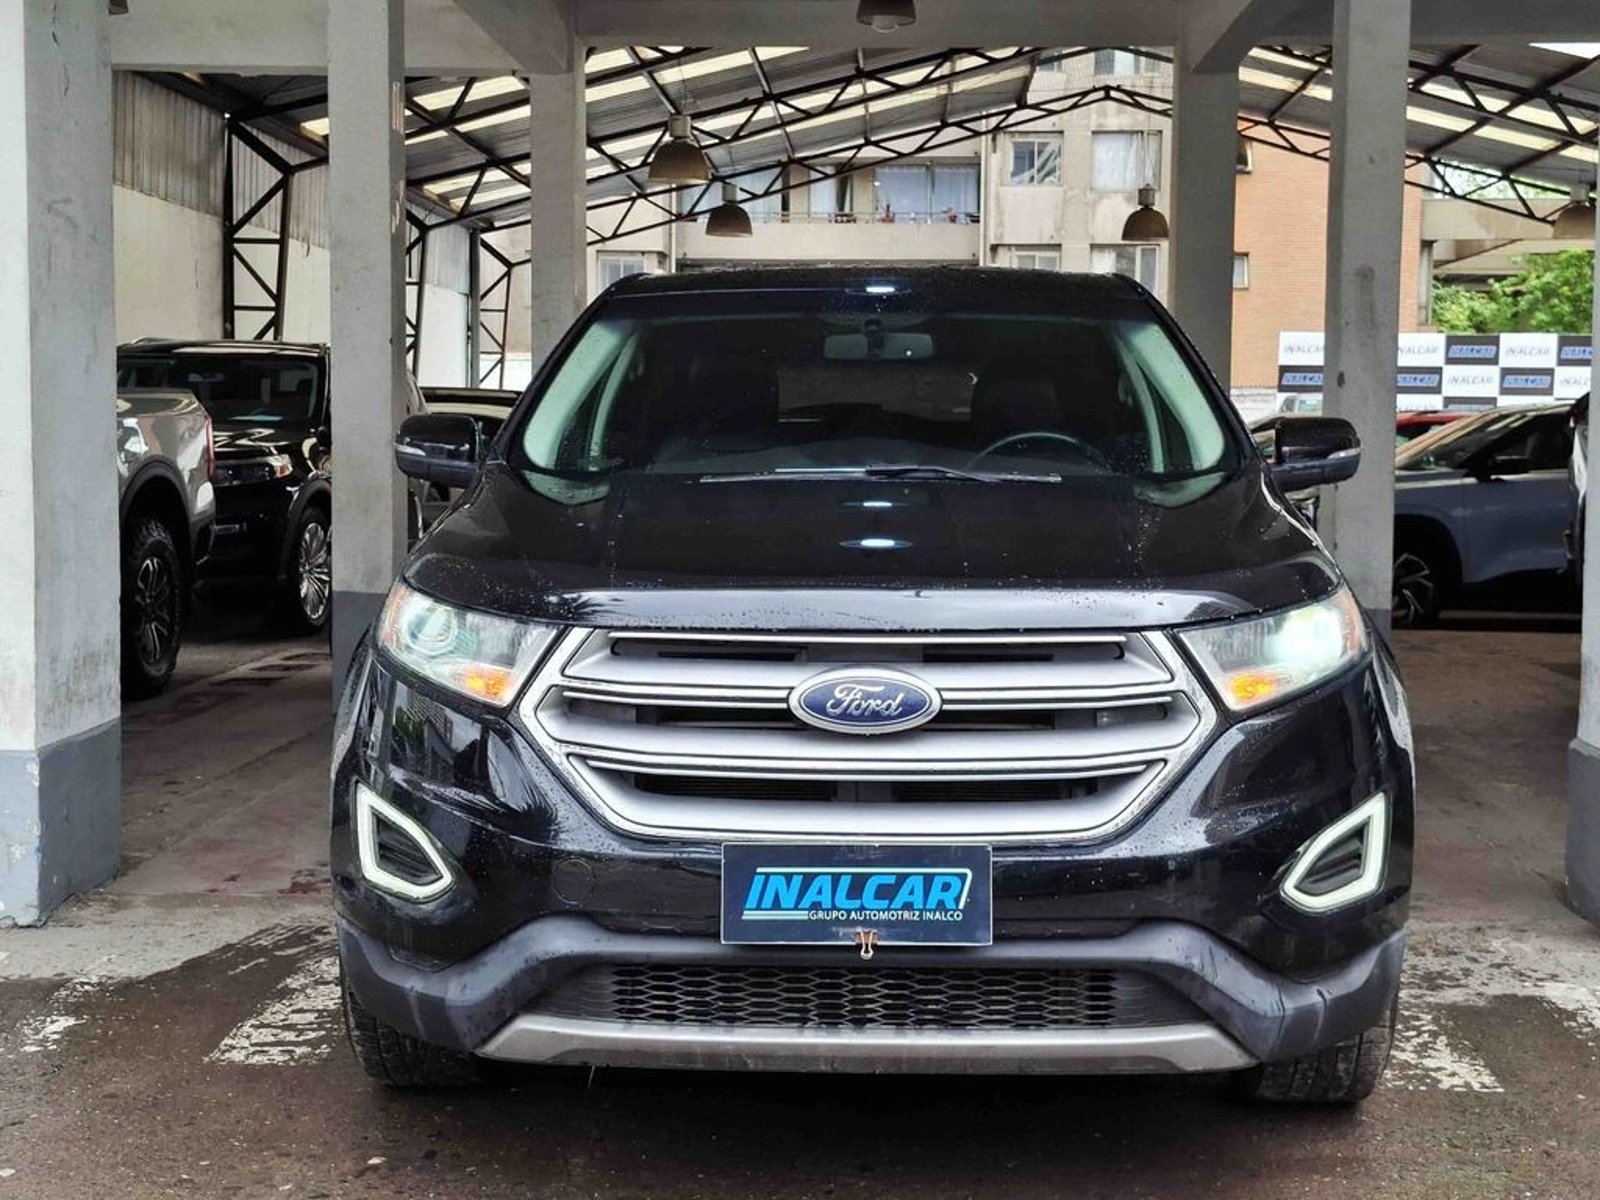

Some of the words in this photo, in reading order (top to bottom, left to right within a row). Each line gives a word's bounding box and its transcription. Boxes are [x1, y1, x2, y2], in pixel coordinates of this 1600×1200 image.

[826, 683, 905, 716] Ford
[744, 874, 963, 910] INALCAR
[808, 910, 847, 921] GRUPO
[849, 910, 920, 921] AUTOMOTRIZ
[922, 911, 963, 922] INALCO
